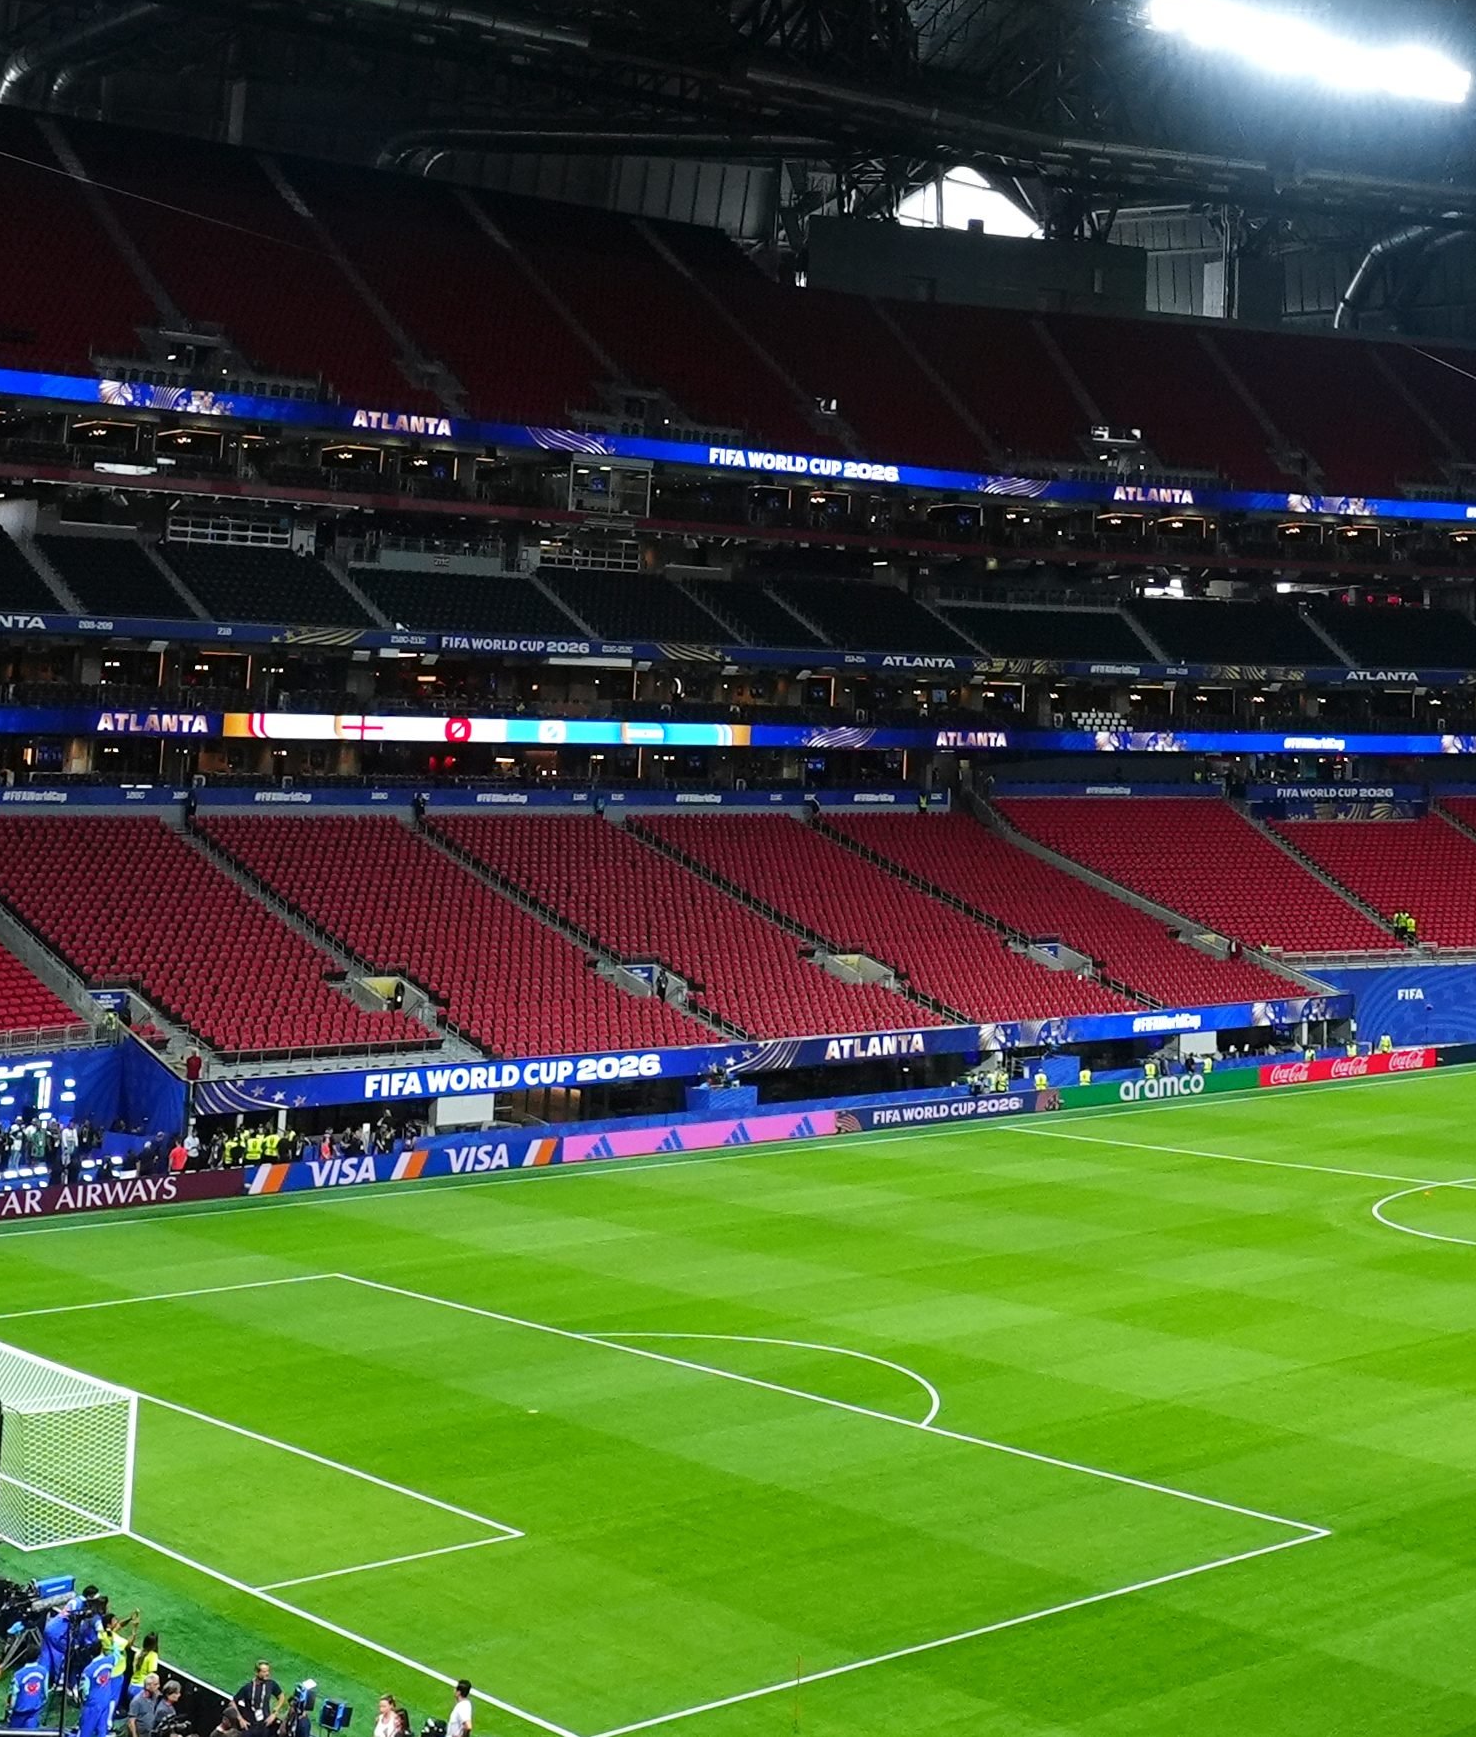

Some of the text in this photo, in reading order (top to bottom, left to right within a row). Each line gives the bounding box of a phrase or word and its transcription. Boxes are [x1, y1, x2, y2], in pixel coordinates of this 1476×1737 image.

[352, 410, 452, 437] ATLANTA
[709, 446, 900, 482] FIFA WORLD CUP 2026
[1114, 486, 1194, 505] ATLANTA
[441, 636, 470, 650] FIFA
[473, 637, 517, 652] WORLD
[519, 639, 545, 653] CUP
[547, 641, 589, 654] 2026
[882, 656, 955, 669] ATLANTA
[1346, 671, 1418, 682] ATLANTA
[97, 712, 209, 734] ATLANTA
[936, 730, 1007, 747] ATLANTA
[1276, 788, 1394, 799] FIFA WORLD CUP 2026
[1398, 988, 1424, 1001] FIFA
[825, 1033, 925, 1061] ATLANTA
[1331, 1056, 1368, 1078] Coca-Cola
[1388, 1050, 1424, 1071] Coca-Cola
[365, 1054, 662, 1098] FIFA WORLD CUP 2026
[1269, 1063, 1308, 1085] Coca-Cola
[1120, 1074, 1204, 1101] aramco
[873, 1097, 1020, 1125] FIFA WORLD CUP 2026
[444, 1144, 510, 1173] VISA
[306, 1156, 376, 1187] VISA
[56, 1177, 177, 1210] AIRWAYS
